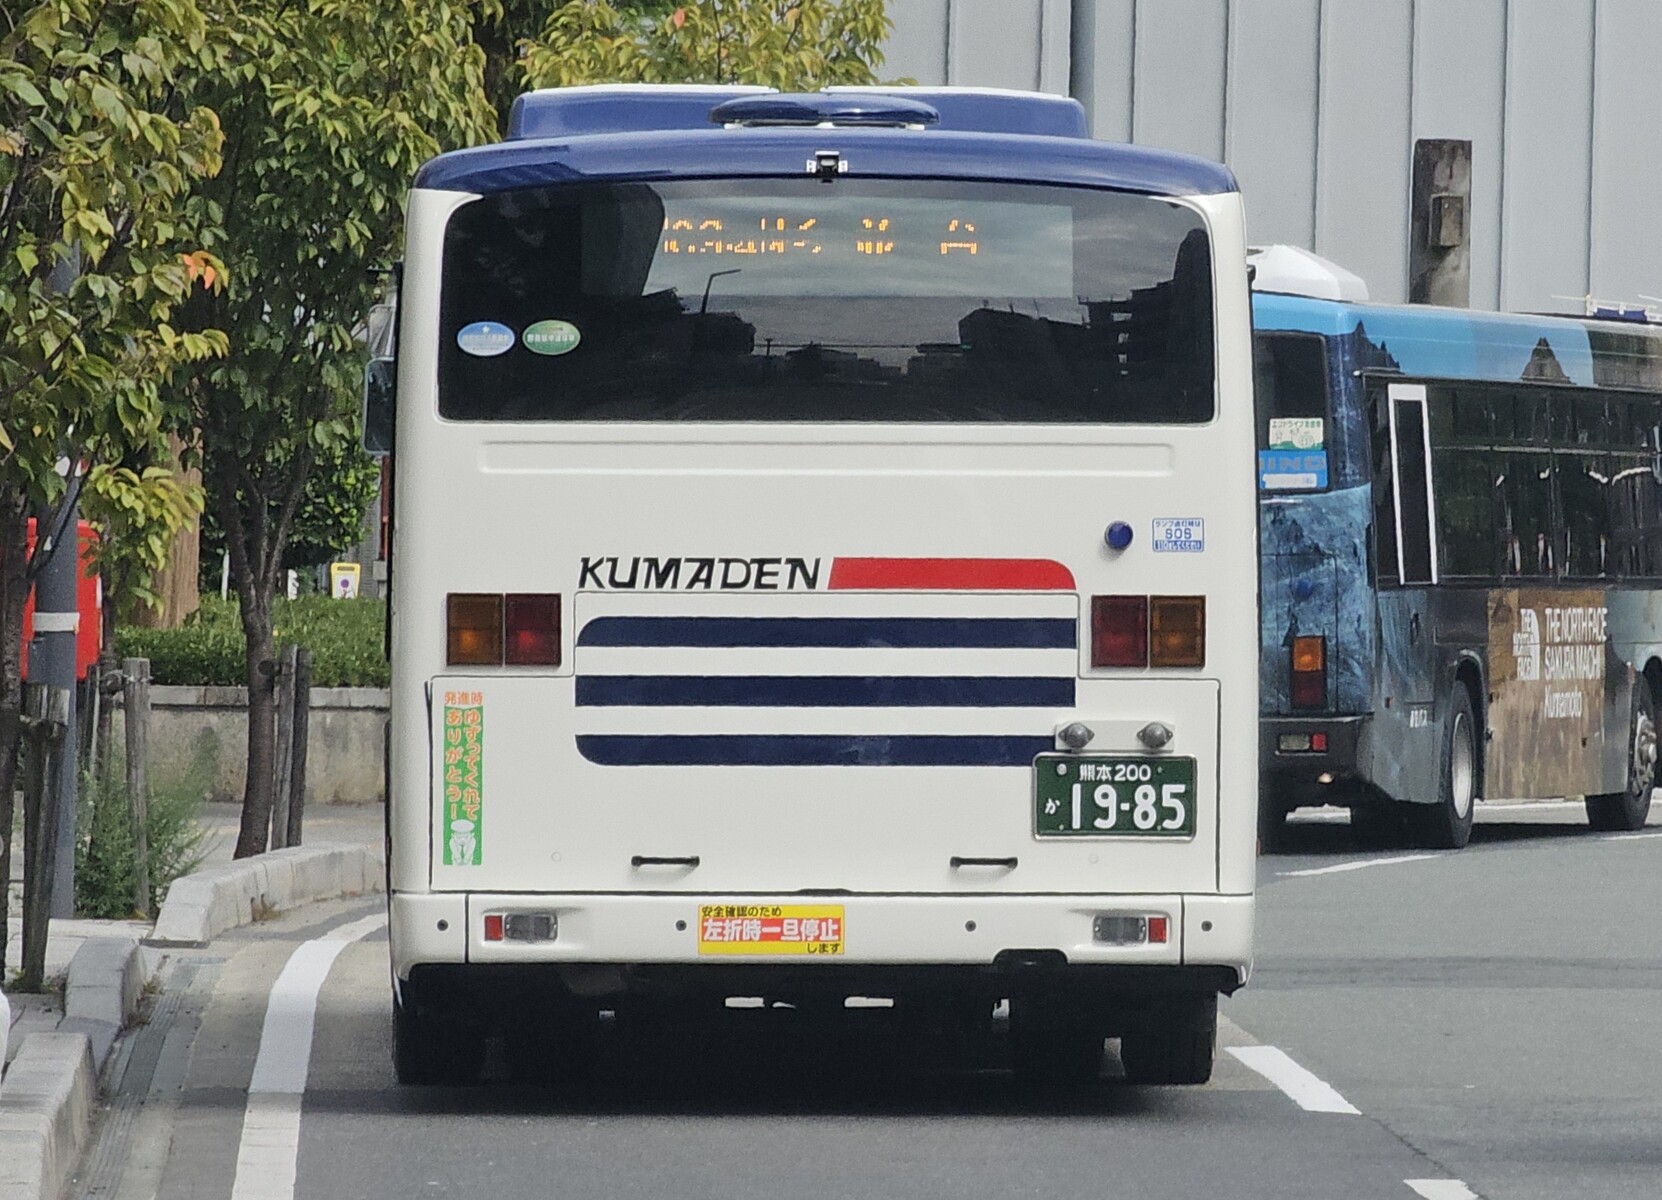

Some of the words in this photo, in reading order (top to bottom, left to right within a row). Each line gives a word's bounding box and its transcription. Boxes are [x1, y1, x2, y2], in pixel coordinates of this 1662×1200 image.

[1259, 455, 1324, 471] INO
[1165, 528, 1192, 540] SOS
[578, 557, 821, 590] KUMADEN
[1545, 607, 1561, 643] THE
[1561, 607, 1588, 642] NORTH
[1588, 607, 1608, 642] FACE
[444, 691, 483, 705] 発進時
[463, 709, 481, 821] ゆずってくれて
[1044, 798, 1061, 815] か
[702, 906, 782, 917] 安全確認のため
[703, 919, 839, 941] 左折時一旦停止
[807, 943, 840, 954] します
